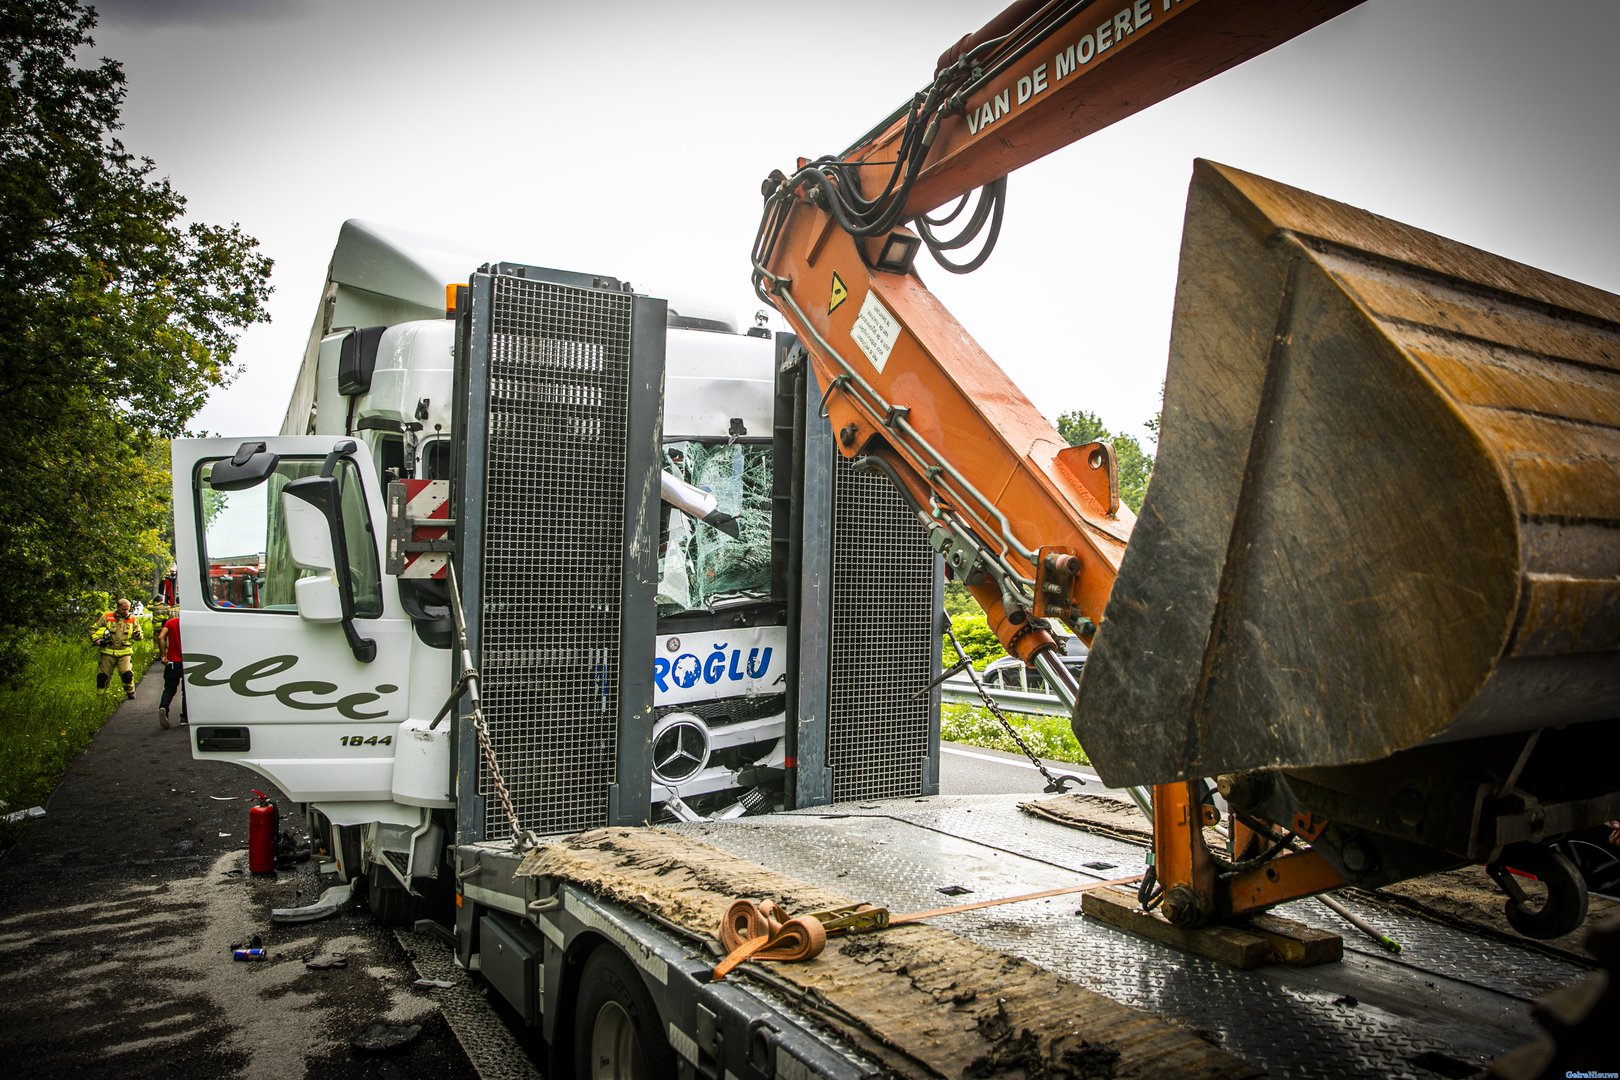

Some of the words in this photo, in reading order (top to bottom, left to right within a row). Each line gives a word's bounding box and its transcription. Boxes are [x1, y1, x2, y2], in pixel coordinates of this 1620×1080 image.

[966, 88, 1011, 136] VAN
[1017, 63, 1049, 106] DE
[1055, 0, 1153, 82] MOERE
[339, 735, 393, 747] 1844
